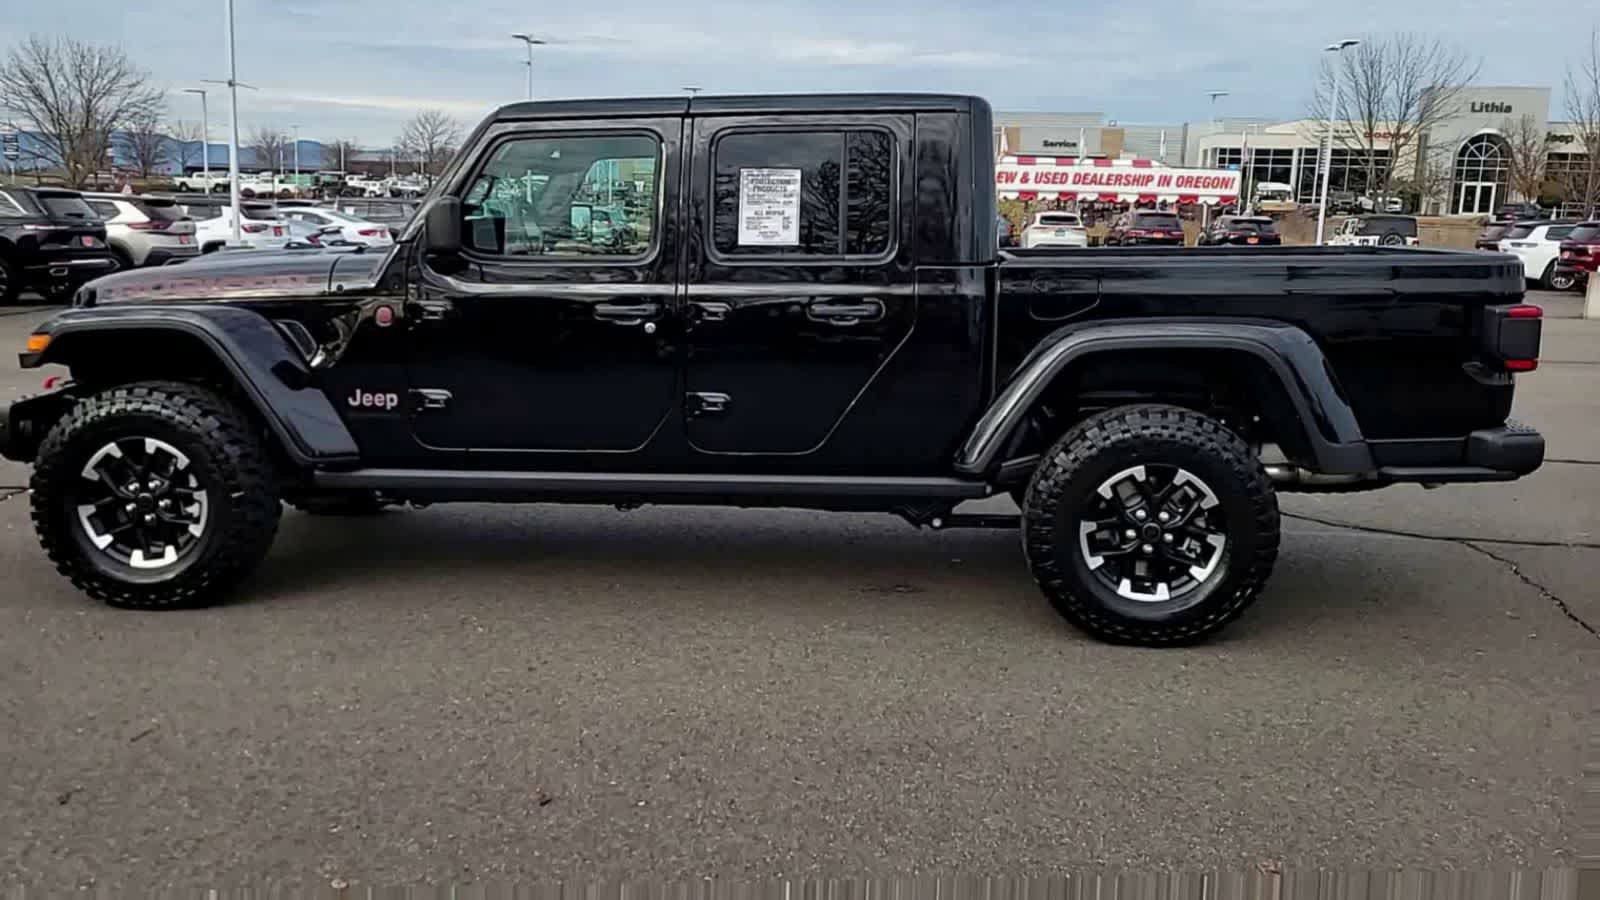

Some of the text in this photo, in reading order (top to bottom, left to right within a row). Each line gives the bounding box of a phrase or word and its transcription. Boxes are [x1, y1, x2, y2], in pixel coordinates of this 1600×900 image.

[1470, 101, 1513, 114] Lithia
[1042, 139, 1077, 148] Service
[996, 171, 1236, 190] EW & USED DEALERSHIP IN OREGON!
[347, 388, 399, 410] Jeep
